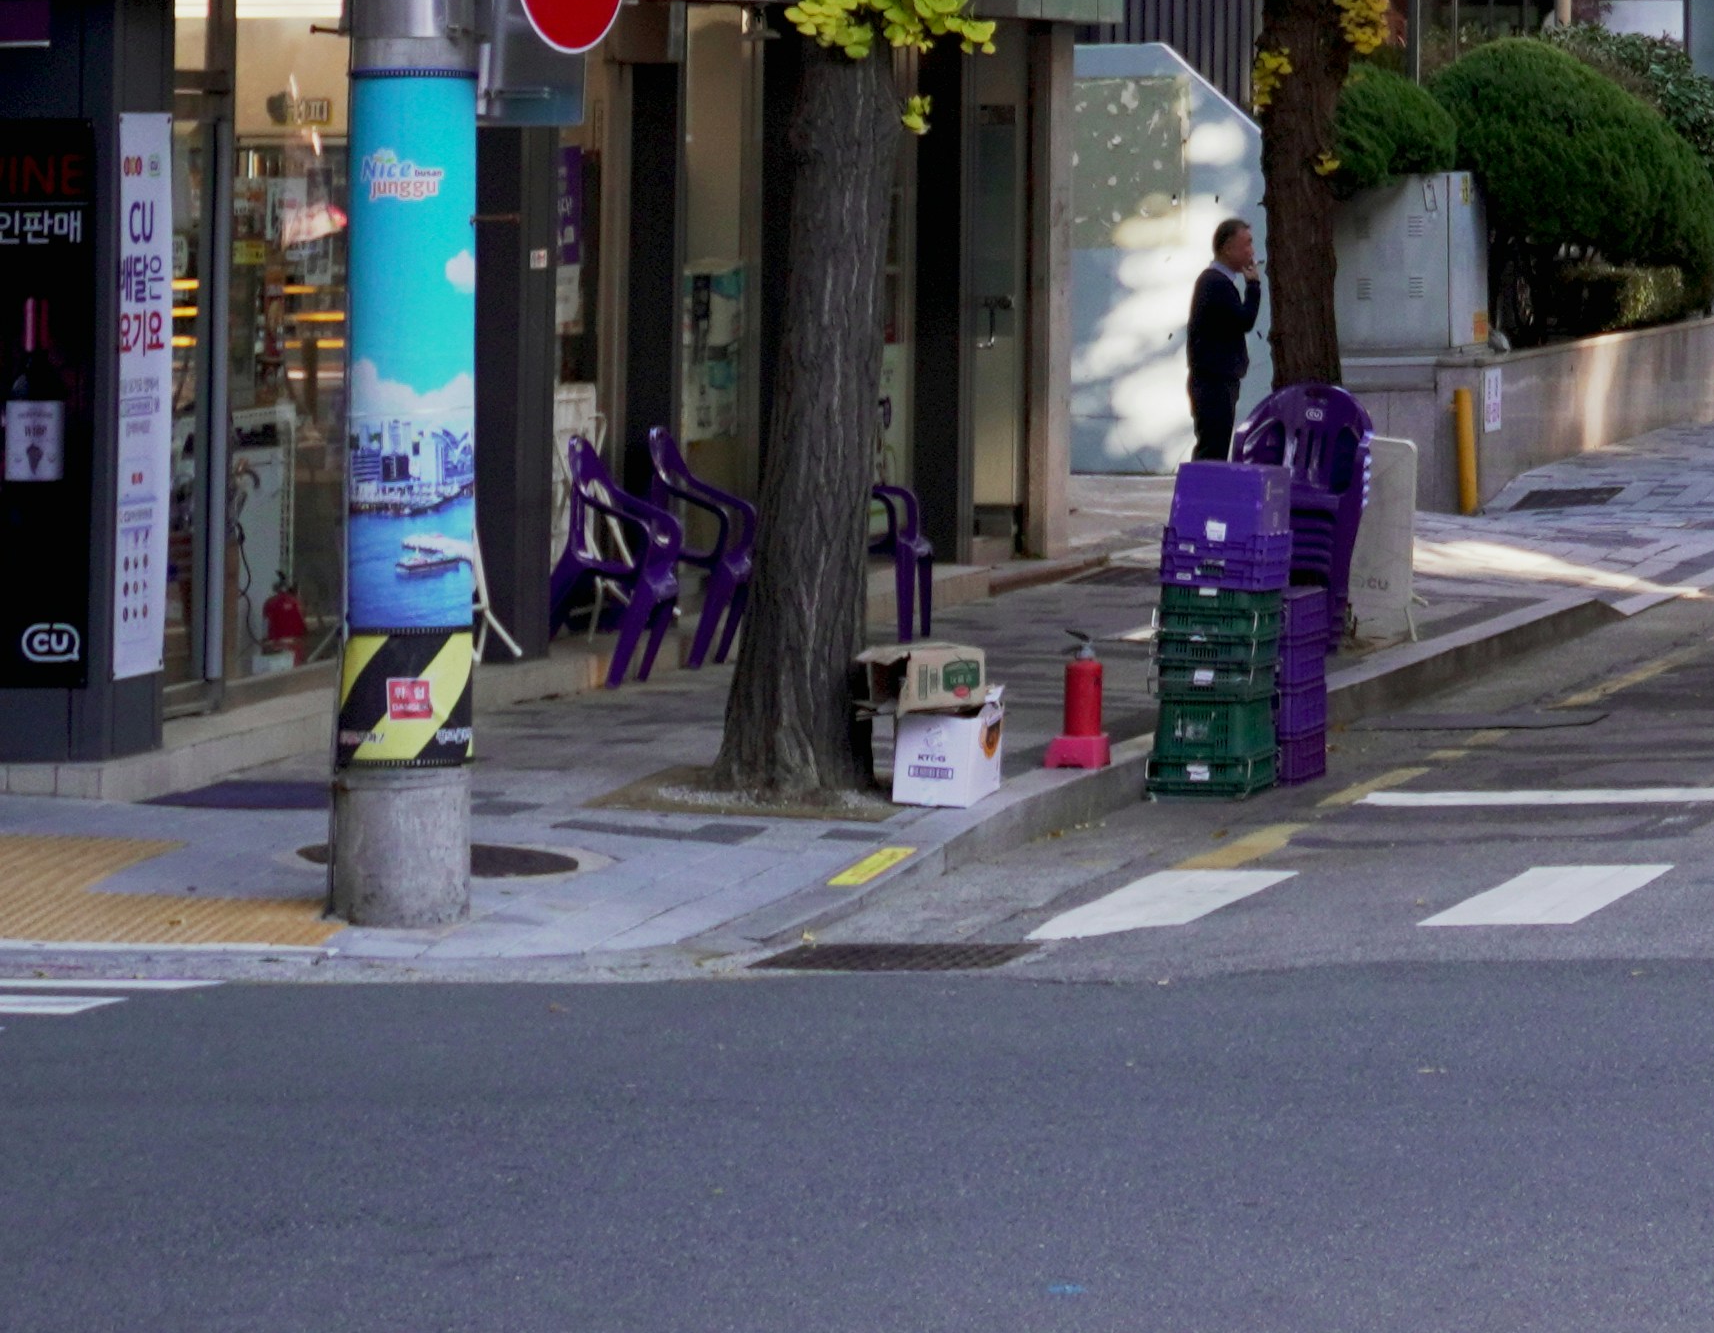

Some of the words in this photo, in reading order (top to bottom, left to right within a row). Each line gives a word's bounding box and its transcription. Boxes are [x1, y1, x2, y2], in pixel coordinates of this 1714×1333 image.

[363, 157, 411, 179] Nice
[370, 180, 436, 199] junggu
[129, 201, 154, 244] CU
[119, 310, 164, 357] 요기요
[32, 632, 69, 653] CU
